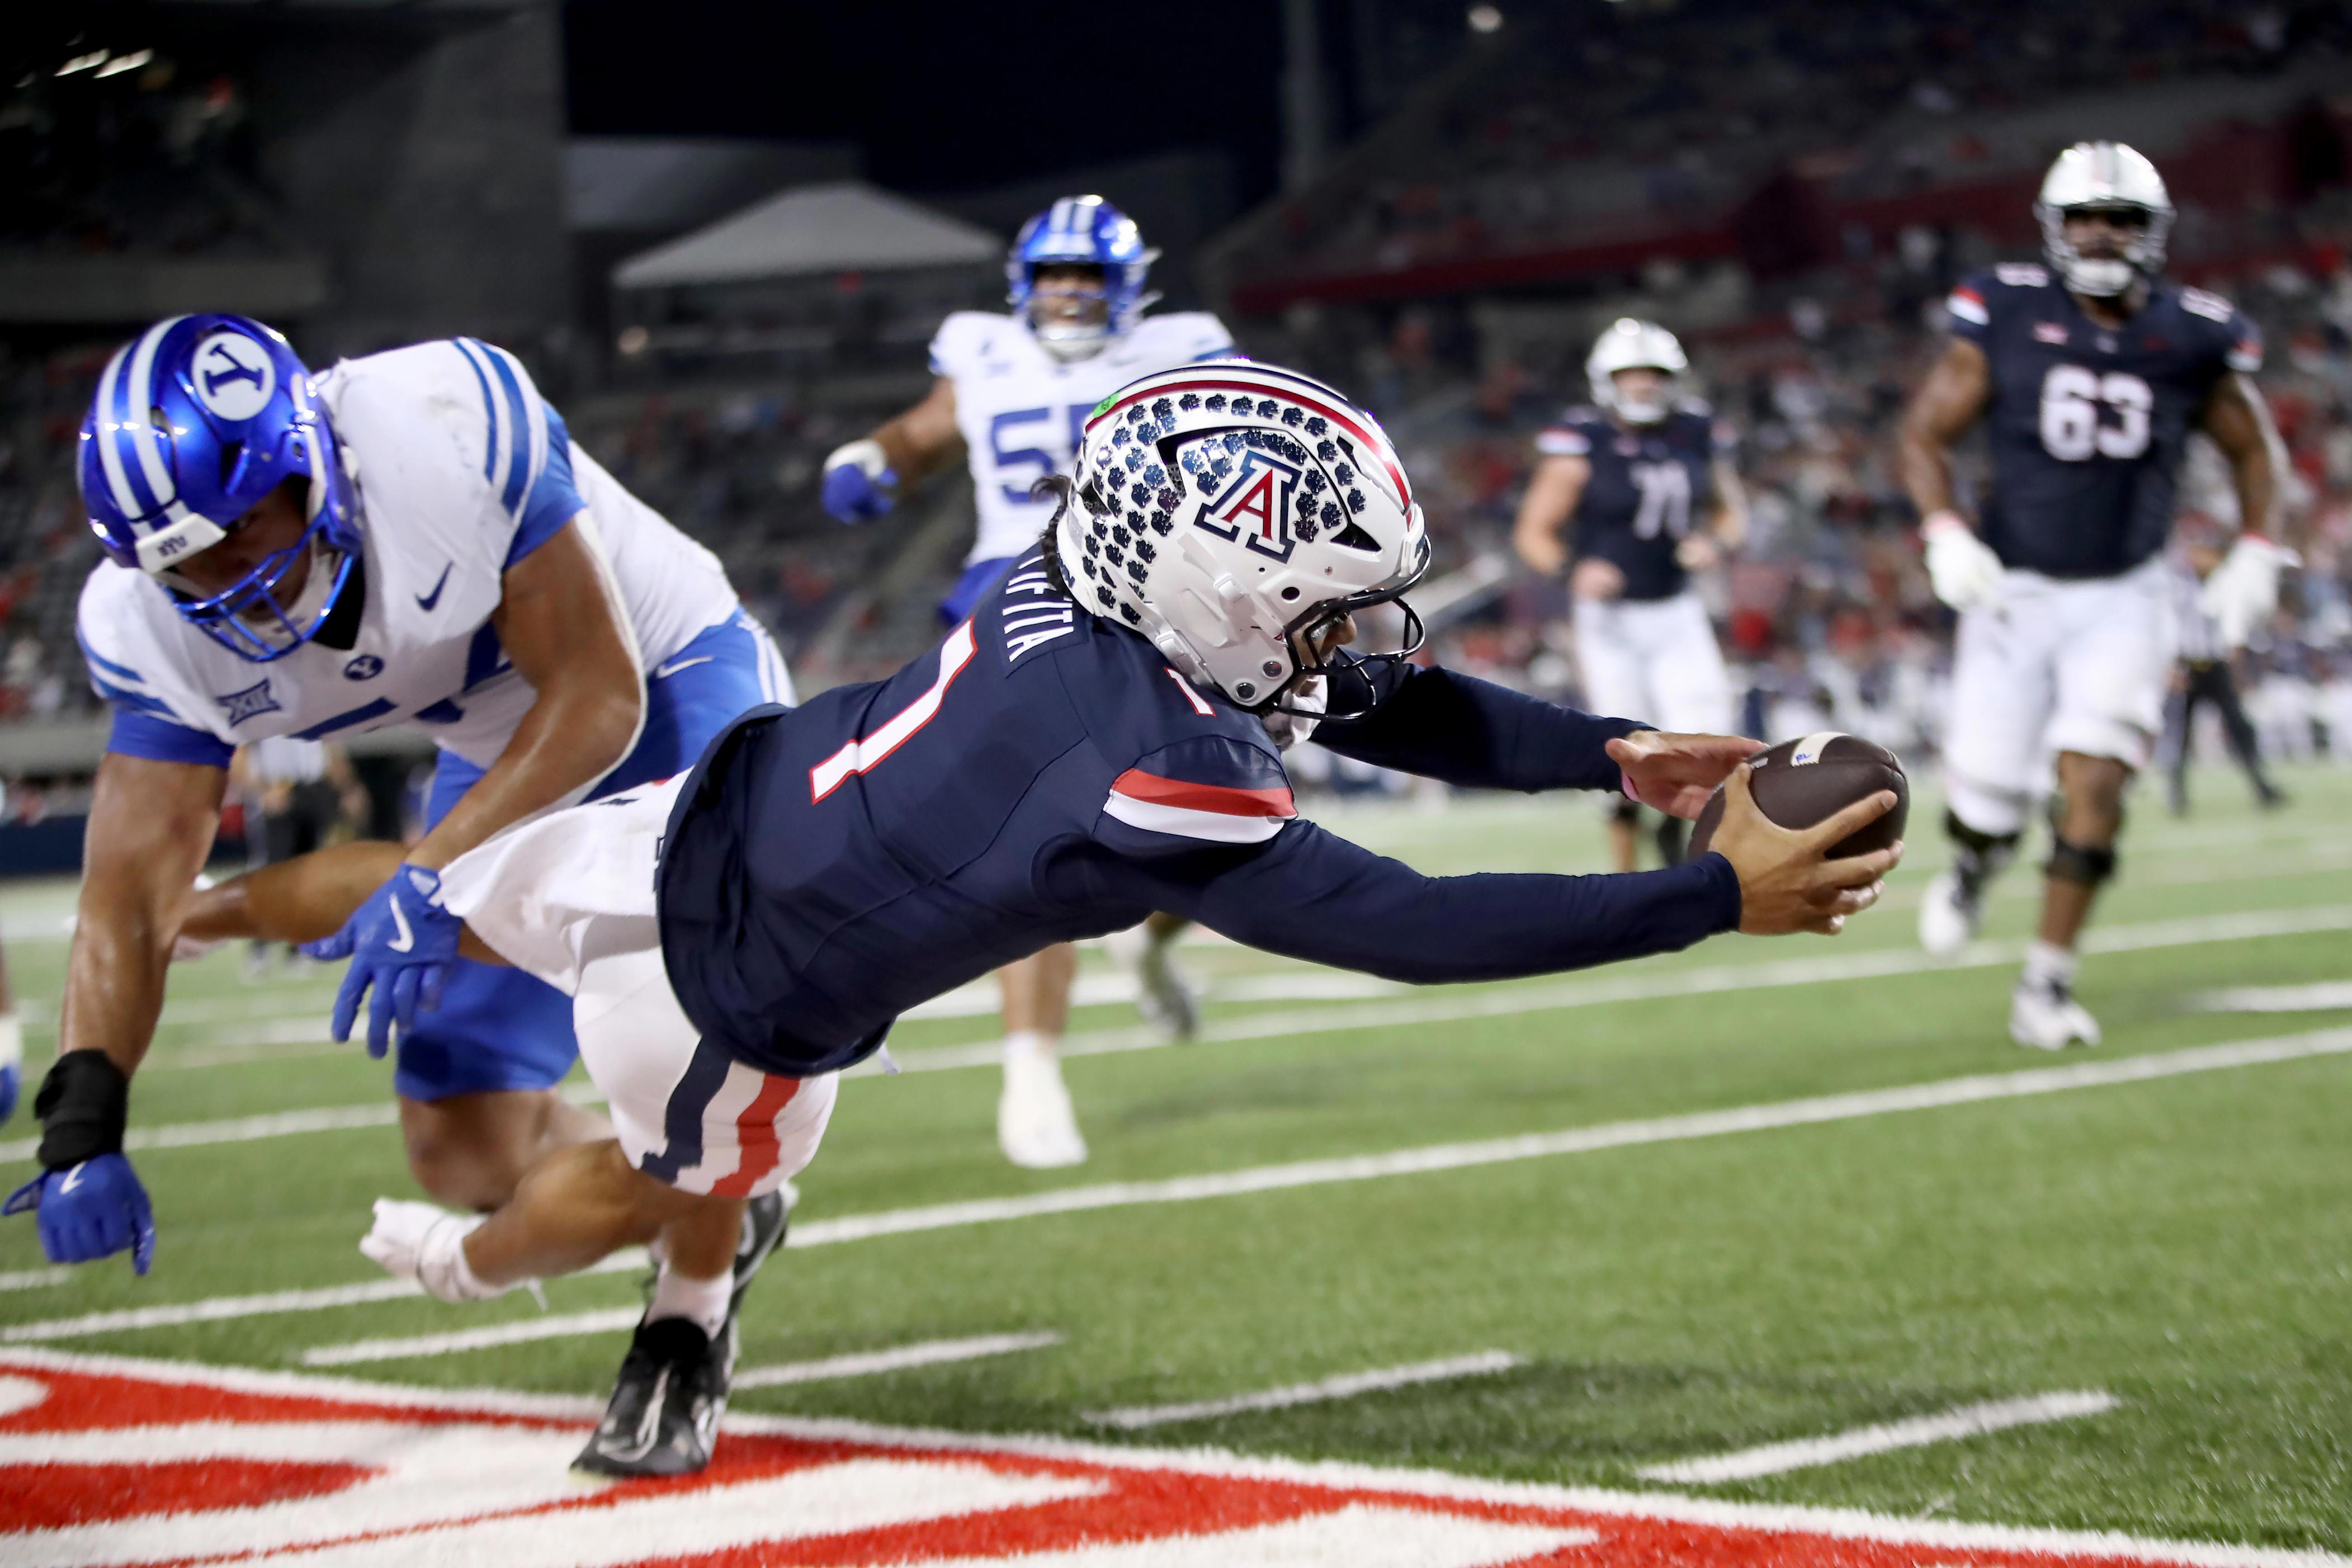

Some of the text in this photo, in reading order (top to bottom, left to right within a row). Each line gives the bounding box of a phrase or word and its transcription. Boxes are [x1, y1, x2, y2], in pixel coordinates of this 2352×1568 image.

[202, 344, 263, 396] Y
[2040, 363, 2153, 461] 63
[991, 399, 1098, 508] 5
[1193, 450, 1302, 564] A
[809, 616, 979, 806] 1
